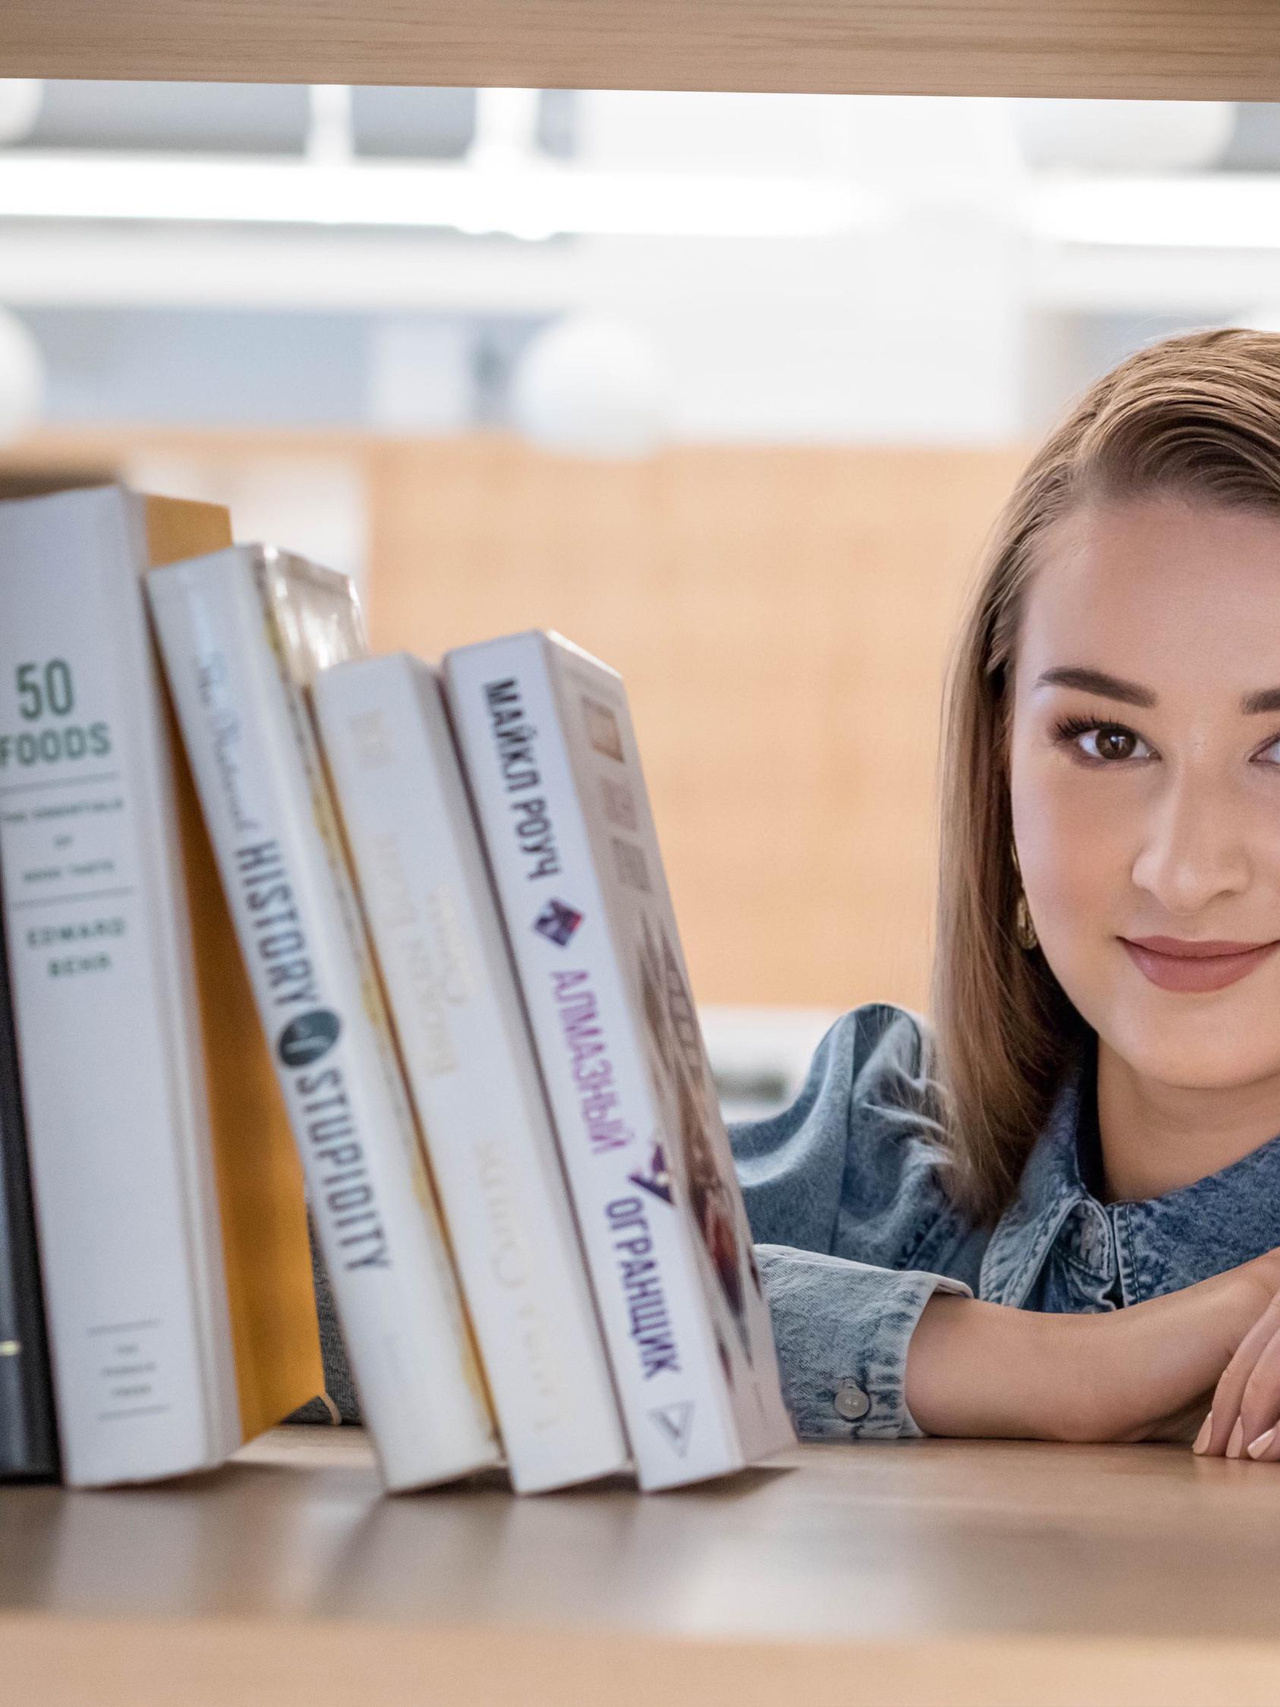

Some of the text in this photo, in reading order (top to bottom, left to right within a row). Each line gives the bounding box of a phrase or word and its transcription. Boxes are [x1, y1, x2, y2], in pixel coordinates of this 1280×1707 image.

[0, 721, 112, 768] FOODS
[16, 658, 74, 721] 50
[482, 676, 563, 881] МАЙКЛ РОУЧ
[26, 916, 127, 950] EDWARD
[236, 840, 320, 1013] HISTORY
[296, 1066, 391, 1272] STUPIDITY
[551, 970, 635, 1155] АЛМАЗНЫЙ
[604, 1196, 683, 1381] ОГРАНЩИК
